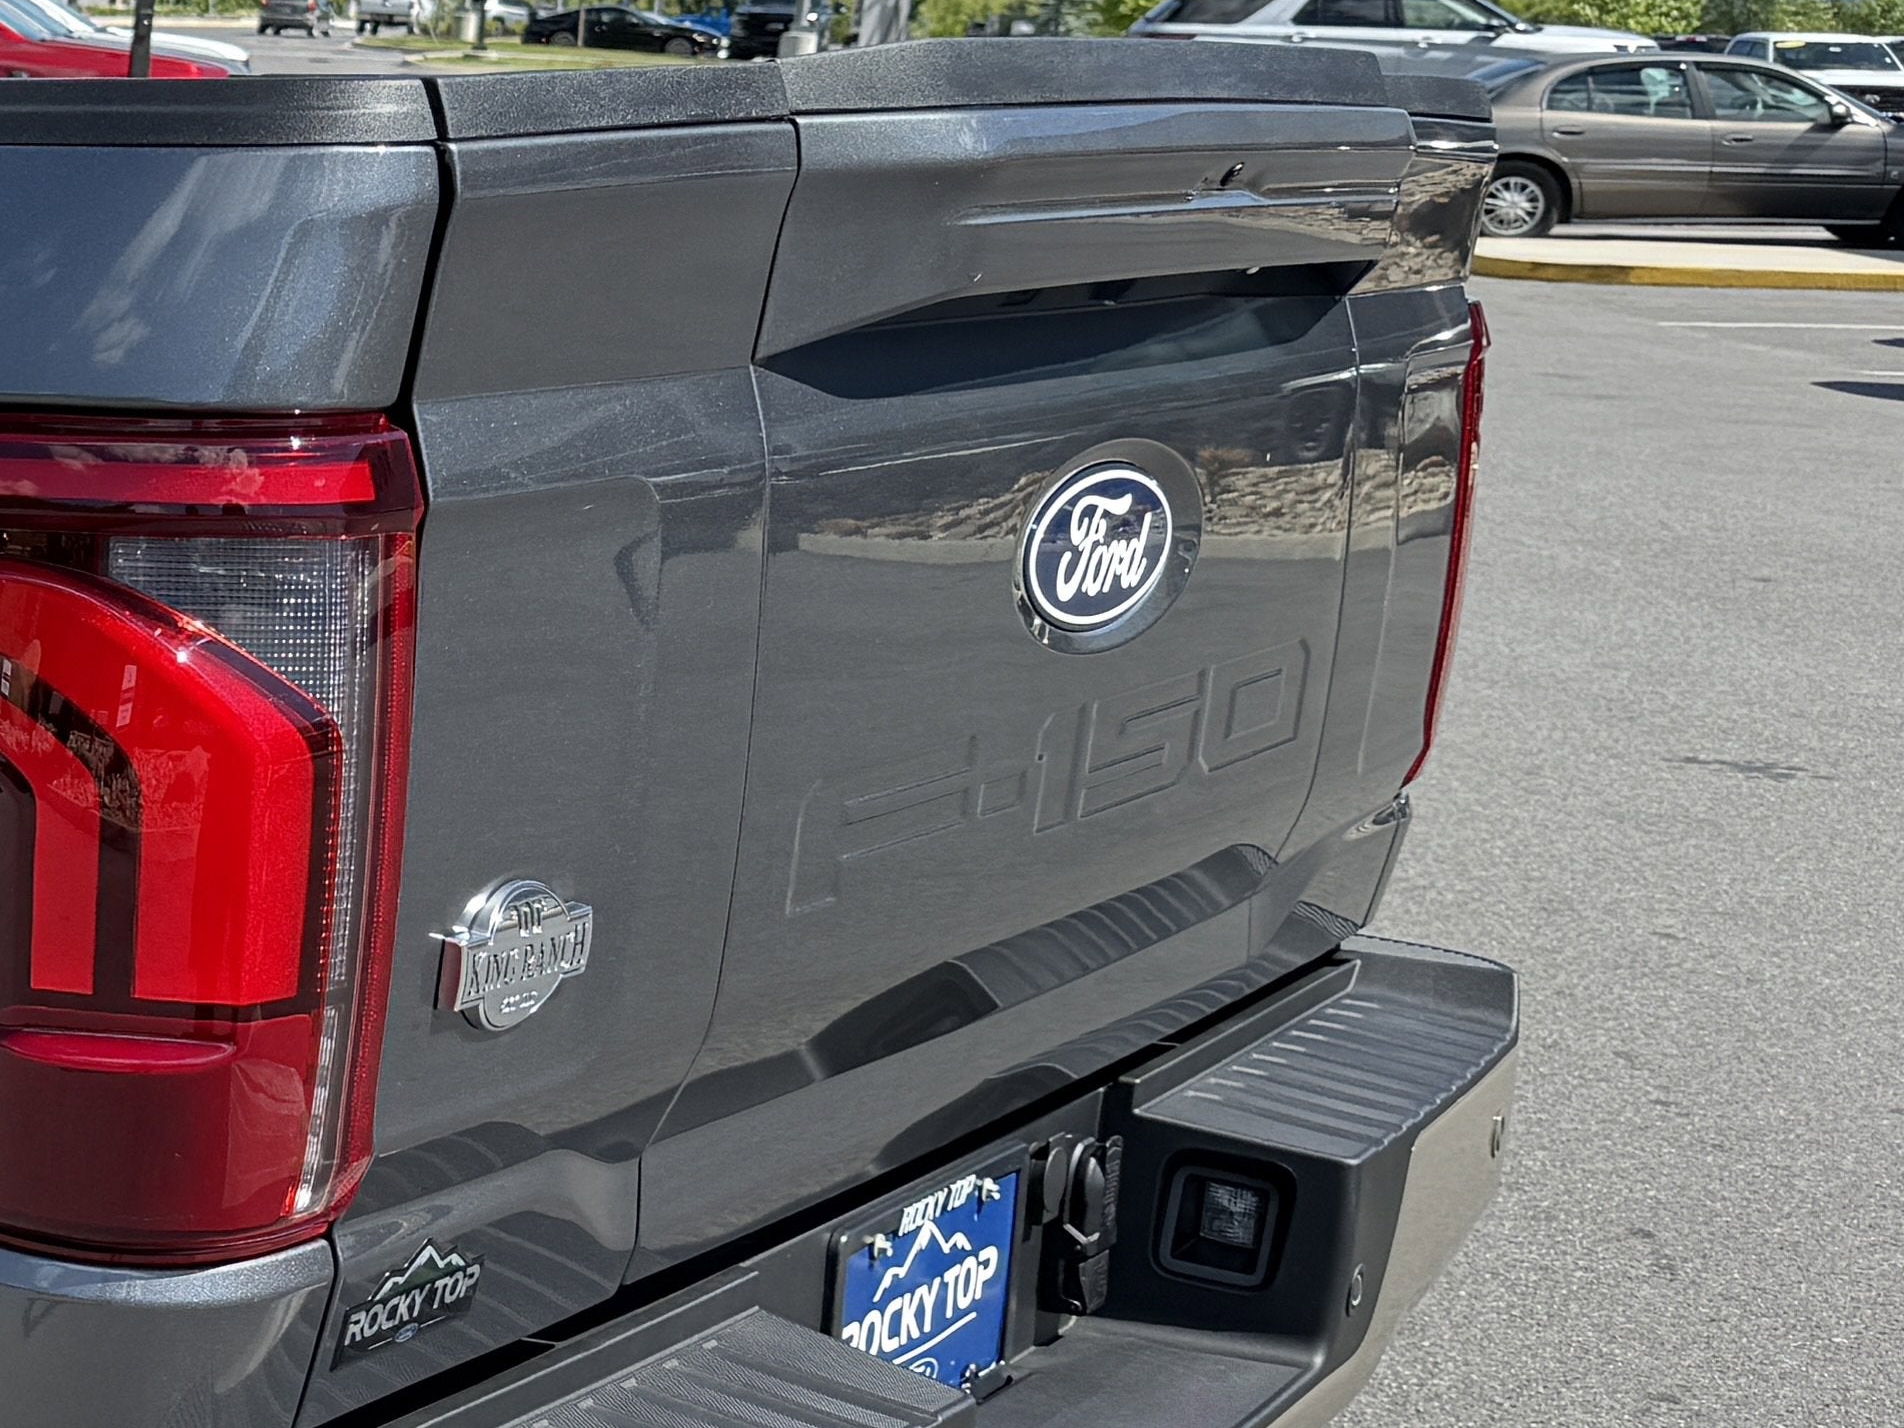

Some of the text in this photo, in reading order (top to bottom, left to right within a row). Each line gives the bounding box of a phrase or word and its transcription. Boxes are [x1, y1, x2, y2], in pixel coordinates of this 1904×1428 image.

[1056, 492, 1151, 602] Ford
[468, 922, 589, 996] KING RANCH
[899, 1174, 976, 1236] ROCKY TOP
[344, 1264, 481, 1346] ROCKY TOP
[944, 1246, 998, 1319] TOP
